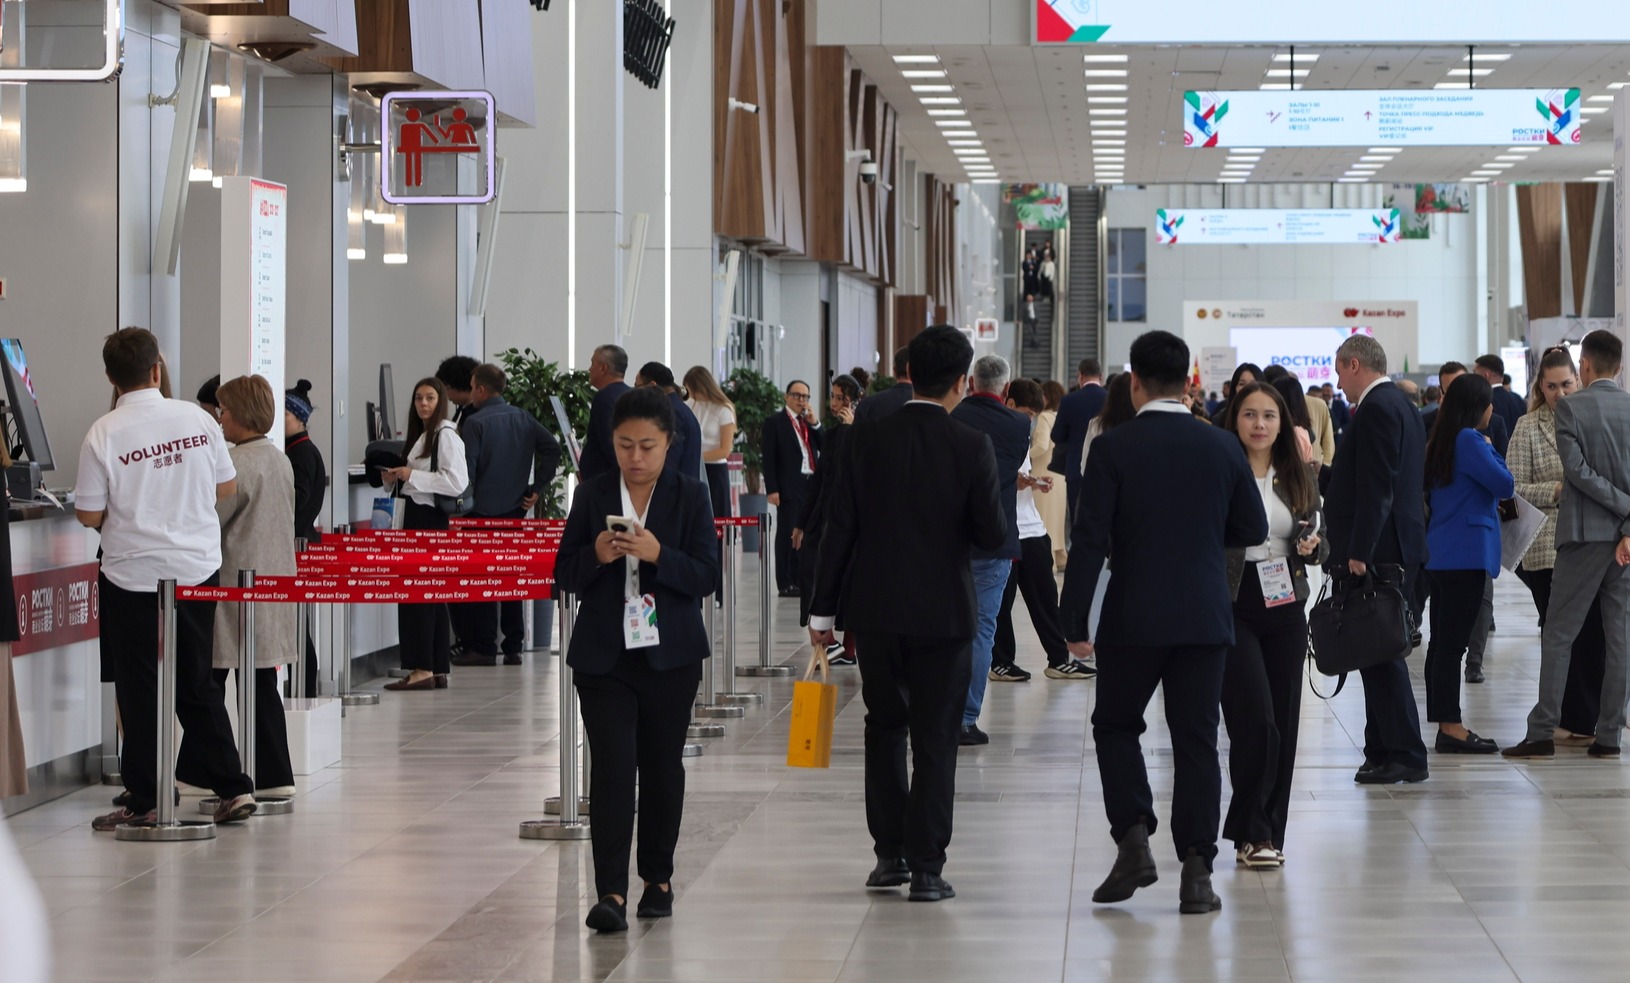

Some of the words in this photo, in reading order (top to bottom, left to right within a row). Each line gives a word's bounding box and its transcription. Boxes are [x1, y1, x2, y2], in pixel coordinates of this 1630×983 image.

[1363, 309, 1385, 317] Kazan
[1387, 309, 1406, 318] Expo
[1271, 356, 1332, 366] РОСТКИ
[119, 435, 208, 466] VOLUNTEER
[153, 453, 183, 469] 志愿者
[377, 566, 390, 574] Expo
[69, 580, 89, 602] РОСТКИ
[193, 589, 212, 597] Kazan
[213, 590, 228, 598] Expo
[513, 589, 528, 597] Expo
[32, 587, 53, 610] РОСТКИ
[273, 592, 288, 600] Expo
[335, 592, 350, 600] Expo
[394, 592, 409, 600] Expo
